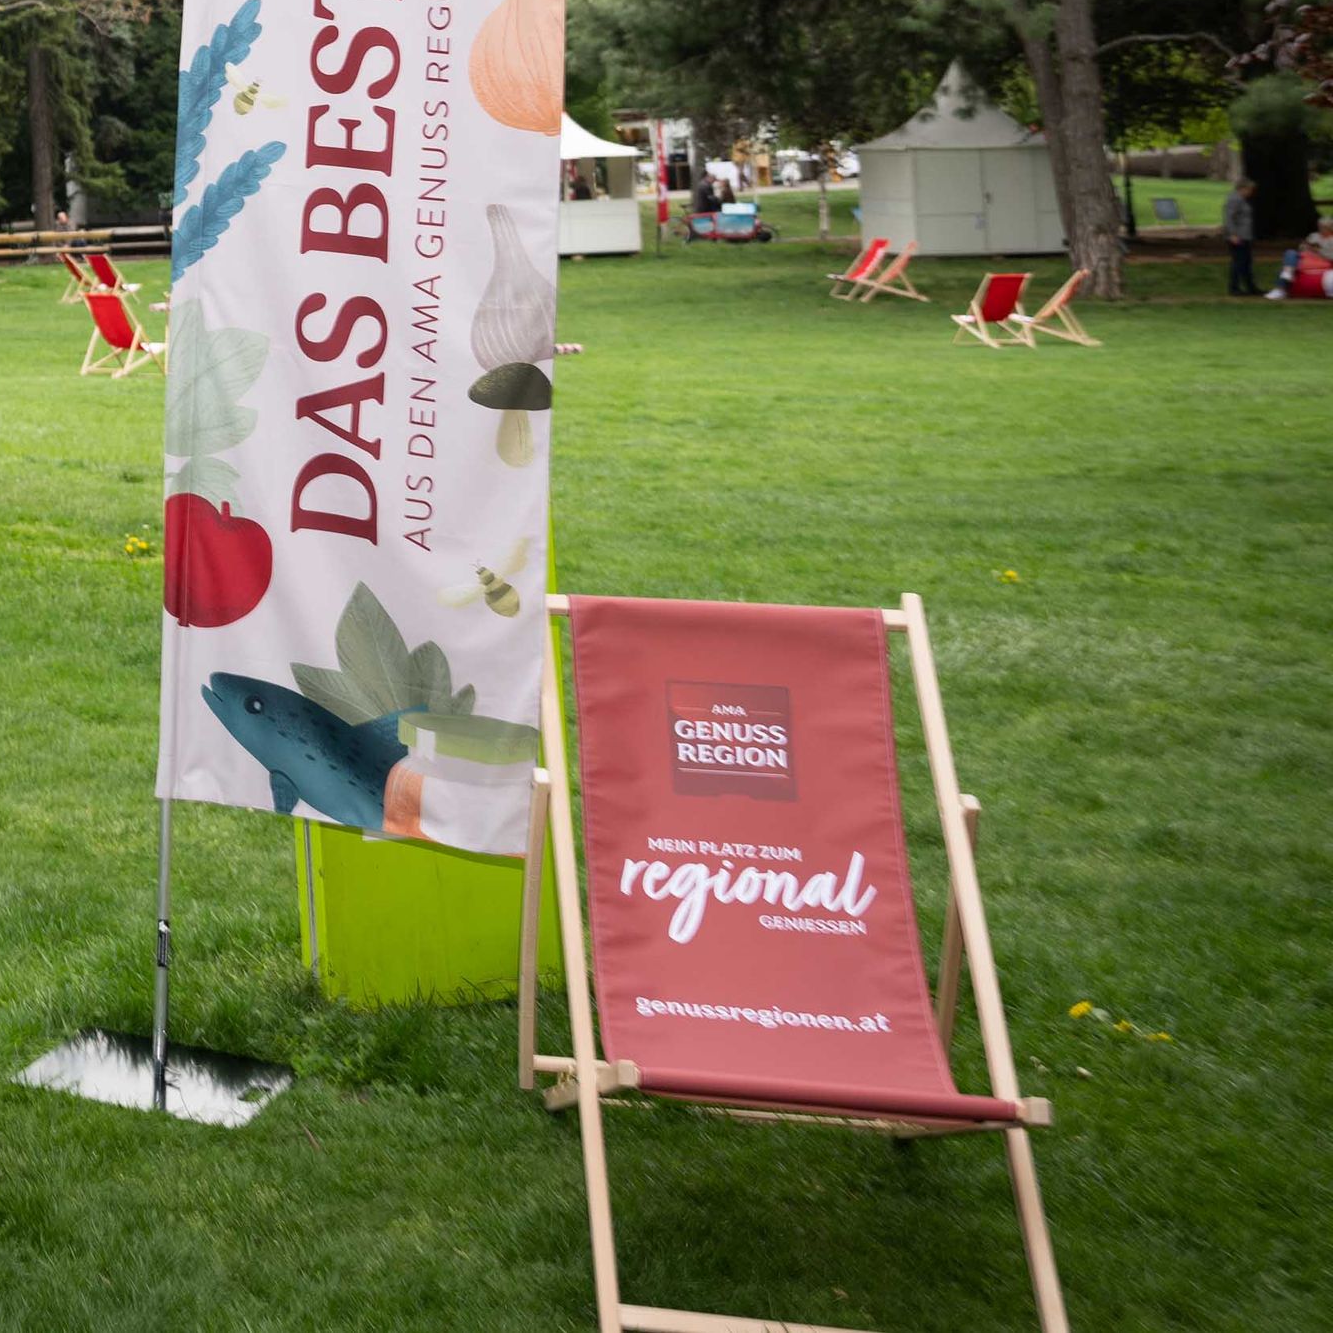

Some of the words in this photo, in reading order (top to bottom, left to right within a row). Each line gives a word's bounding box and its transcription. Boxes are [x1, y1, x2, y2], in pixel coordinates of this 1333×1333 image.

[414, 100, 449, 259] GENUSS
[411, 275, 442, 363] AMA
[290, 292, 388, 546] DAS
[407, 376, 437, 458] DEN
[403, 474, 434, 552] AUS
[674, 719, 788, 745] GENUSS
[677, 742, 788, 768] REGION
[647, 837, 696, 854] MEIN
[698, 840, 756, 858] PLATZ
[759, 844, 803, 862] ZUM
[620, 851, 877, 944] regional
[758, 914, 867, 935] GENIESSEN
[636, 996, 891, 1033] genussregionen.at
